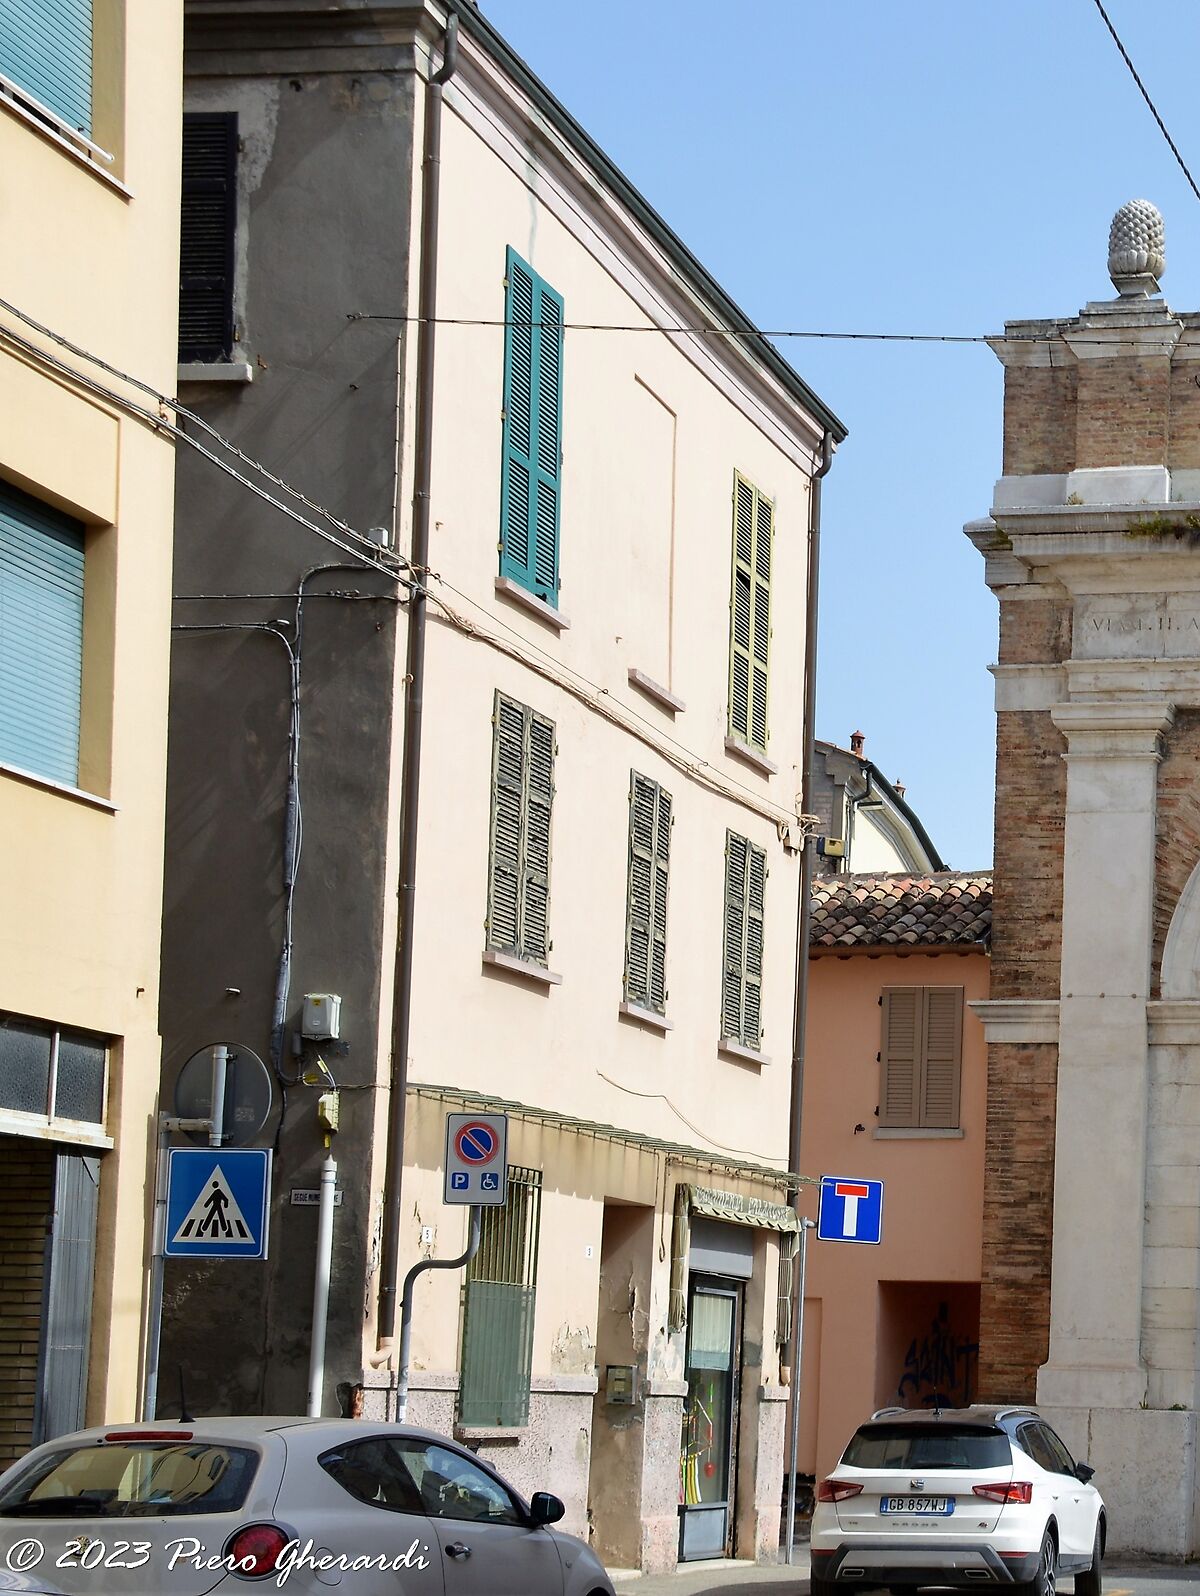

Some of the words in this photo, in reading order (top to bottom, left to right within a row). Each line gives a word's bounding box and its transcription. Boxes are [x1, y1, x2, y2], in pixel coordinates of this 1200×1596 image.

[455, 1174, 466, 1188] P
[889, 1498, 904, 1511] GB
[907, 1498, 946, 1511] 857WJ
